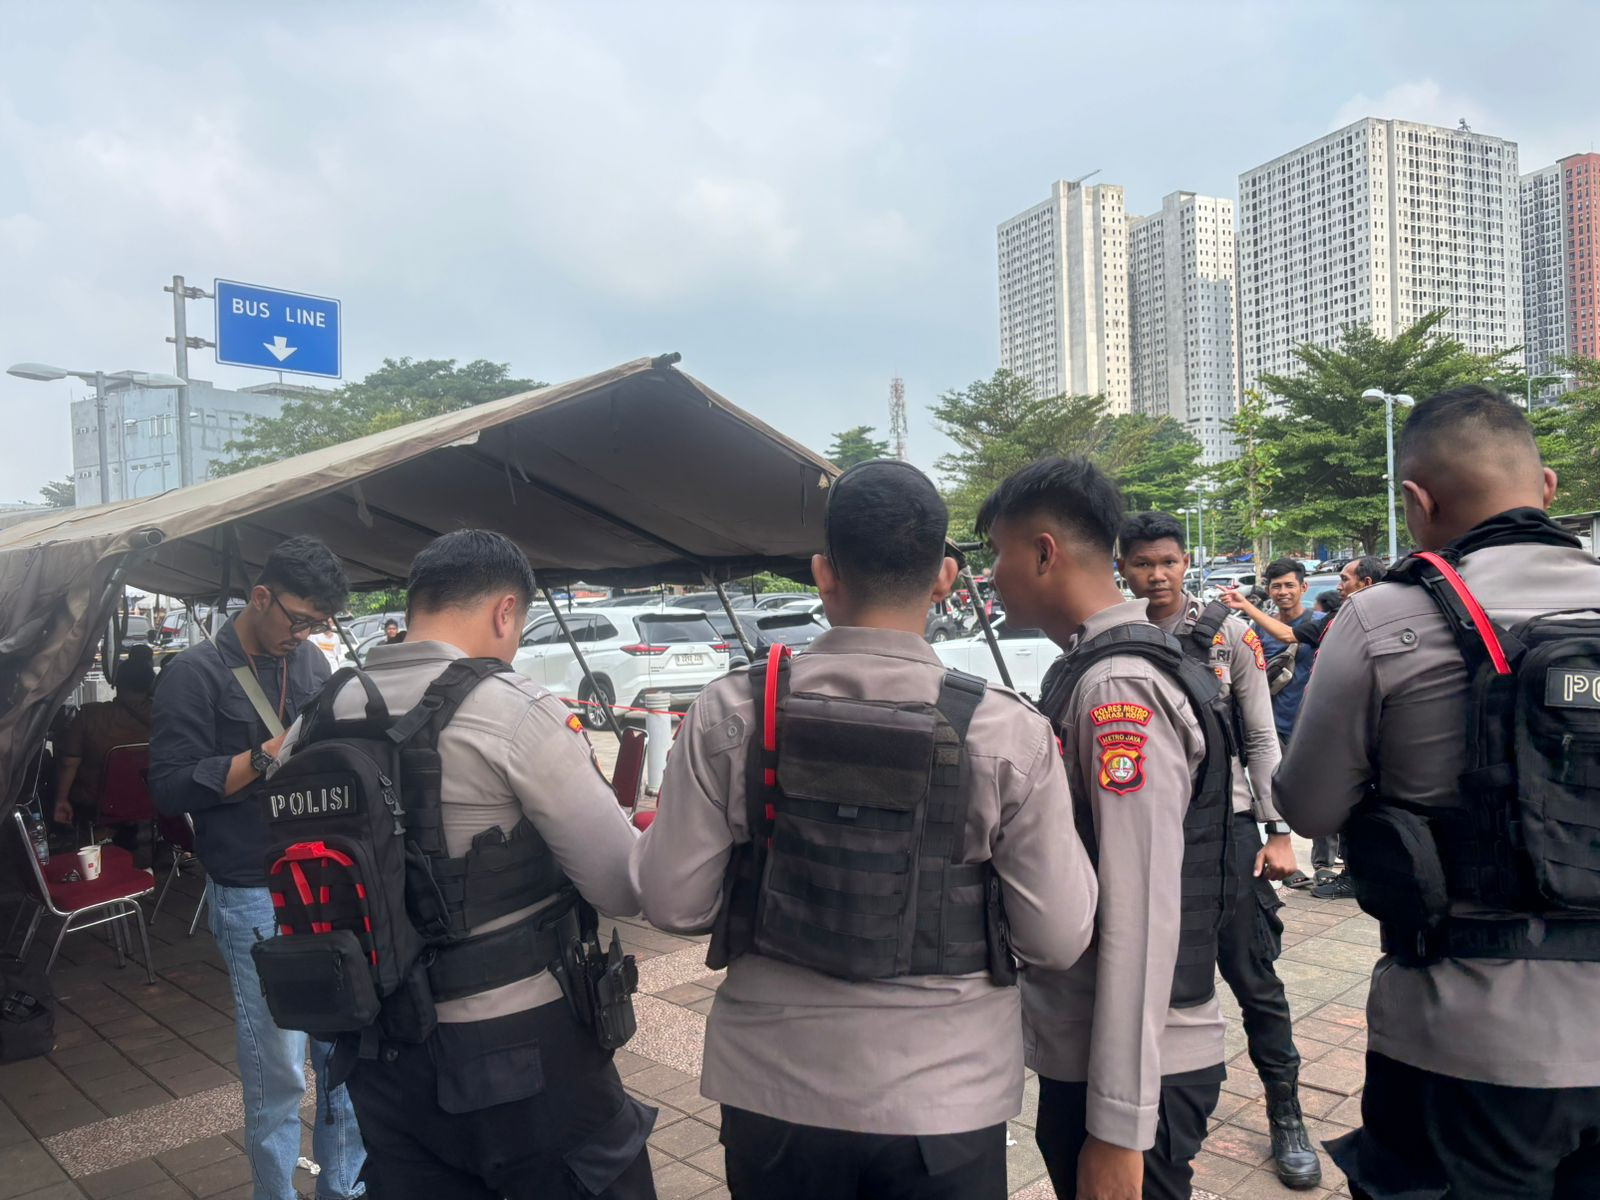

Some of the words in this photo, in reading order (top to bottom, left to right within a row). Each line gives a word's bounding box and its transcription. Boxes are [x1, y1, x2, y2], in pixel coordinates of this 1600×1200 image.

[232, 297, 270, 318] BUS
[286, 307, 326, 328] LINE
[1094, 705, 1122, 718] POLRES
[1123, 705, 1148, 717] METRO
[1097, 713, 1123, 722] BEKASI
[1125, 712, 1144, 722] KOTA
[1102, 734, 1125, 744] METRO
[1125, 734, 1141, 743] JAYA
[270, 785, 349, 818] POLISI
